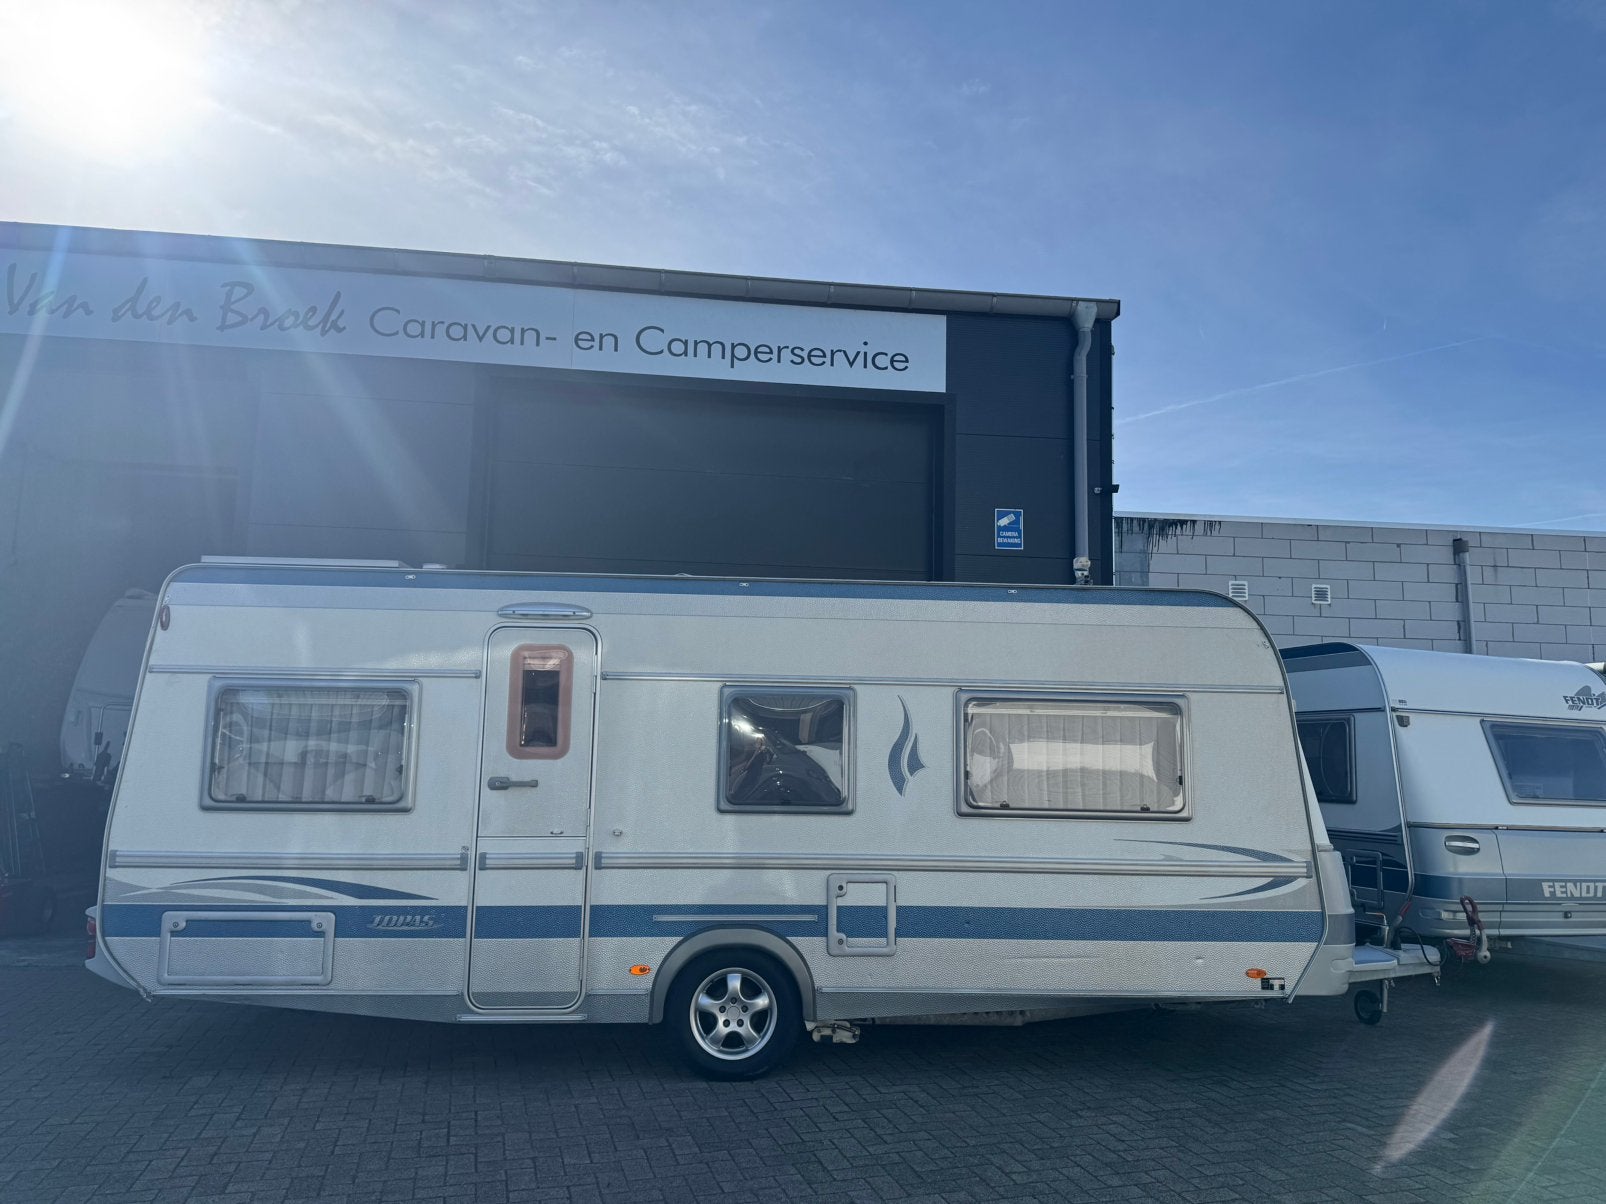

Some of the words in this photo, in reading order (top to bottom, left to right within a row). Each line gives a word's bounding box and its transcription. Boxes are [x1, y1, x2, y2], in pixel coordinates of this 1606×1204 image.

[6, 263, 93, 318] Van
[111, 278, 197, 326] den
[216, 280, 346, 337] Broek
[369, 306, 557, 348] Caravan-
[574, 330, 619, 353] en
[635, 325, 910, 371] Camperservice
[1563, 695, 1600, 706] FENDT
[1541, 882, 1606, 897] FENDT
